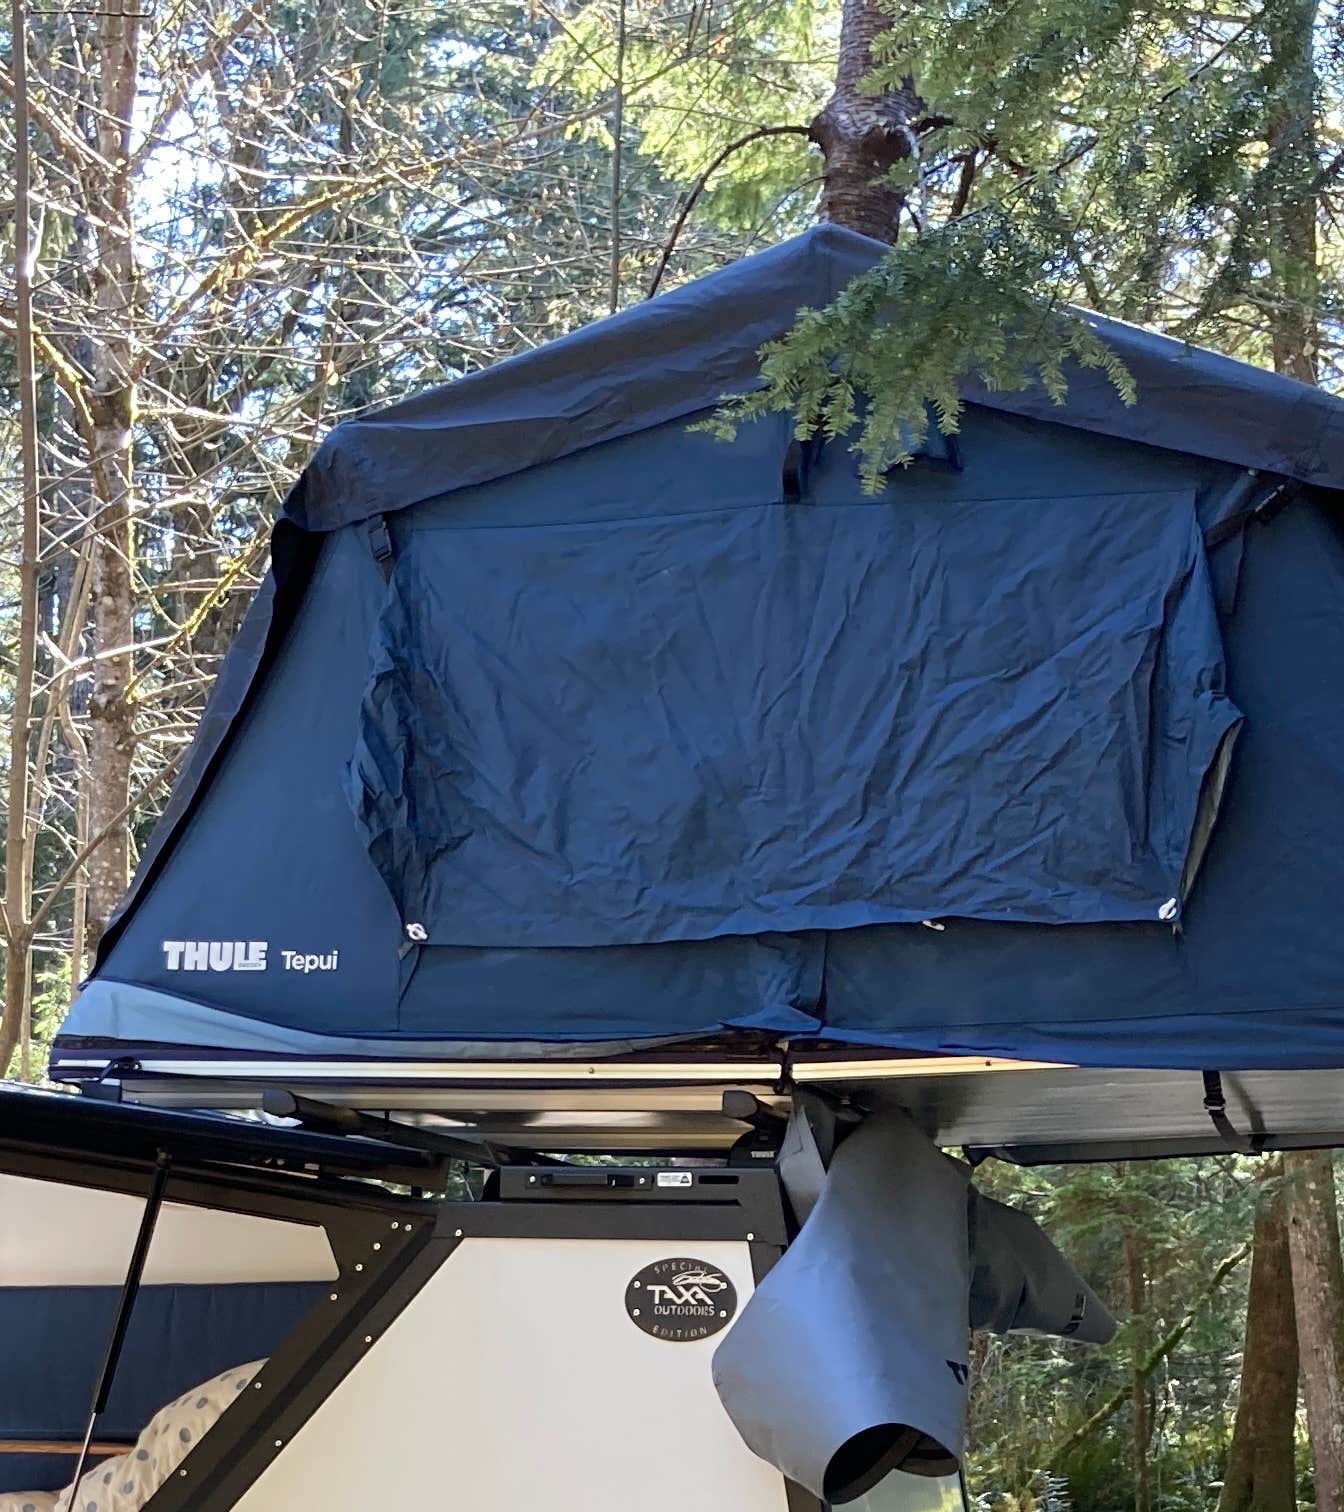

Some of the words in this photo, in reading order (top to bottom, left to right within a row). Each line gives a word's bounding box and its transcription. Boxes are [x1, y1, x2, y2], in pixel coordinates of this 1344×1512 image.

[163, 941, 268, 971] THULE
[281, 950, 339, 973] Tepui
[654, 1305, 715, 1316] OUTDOORS
[652, 1325, 707, 1338] EDITION
